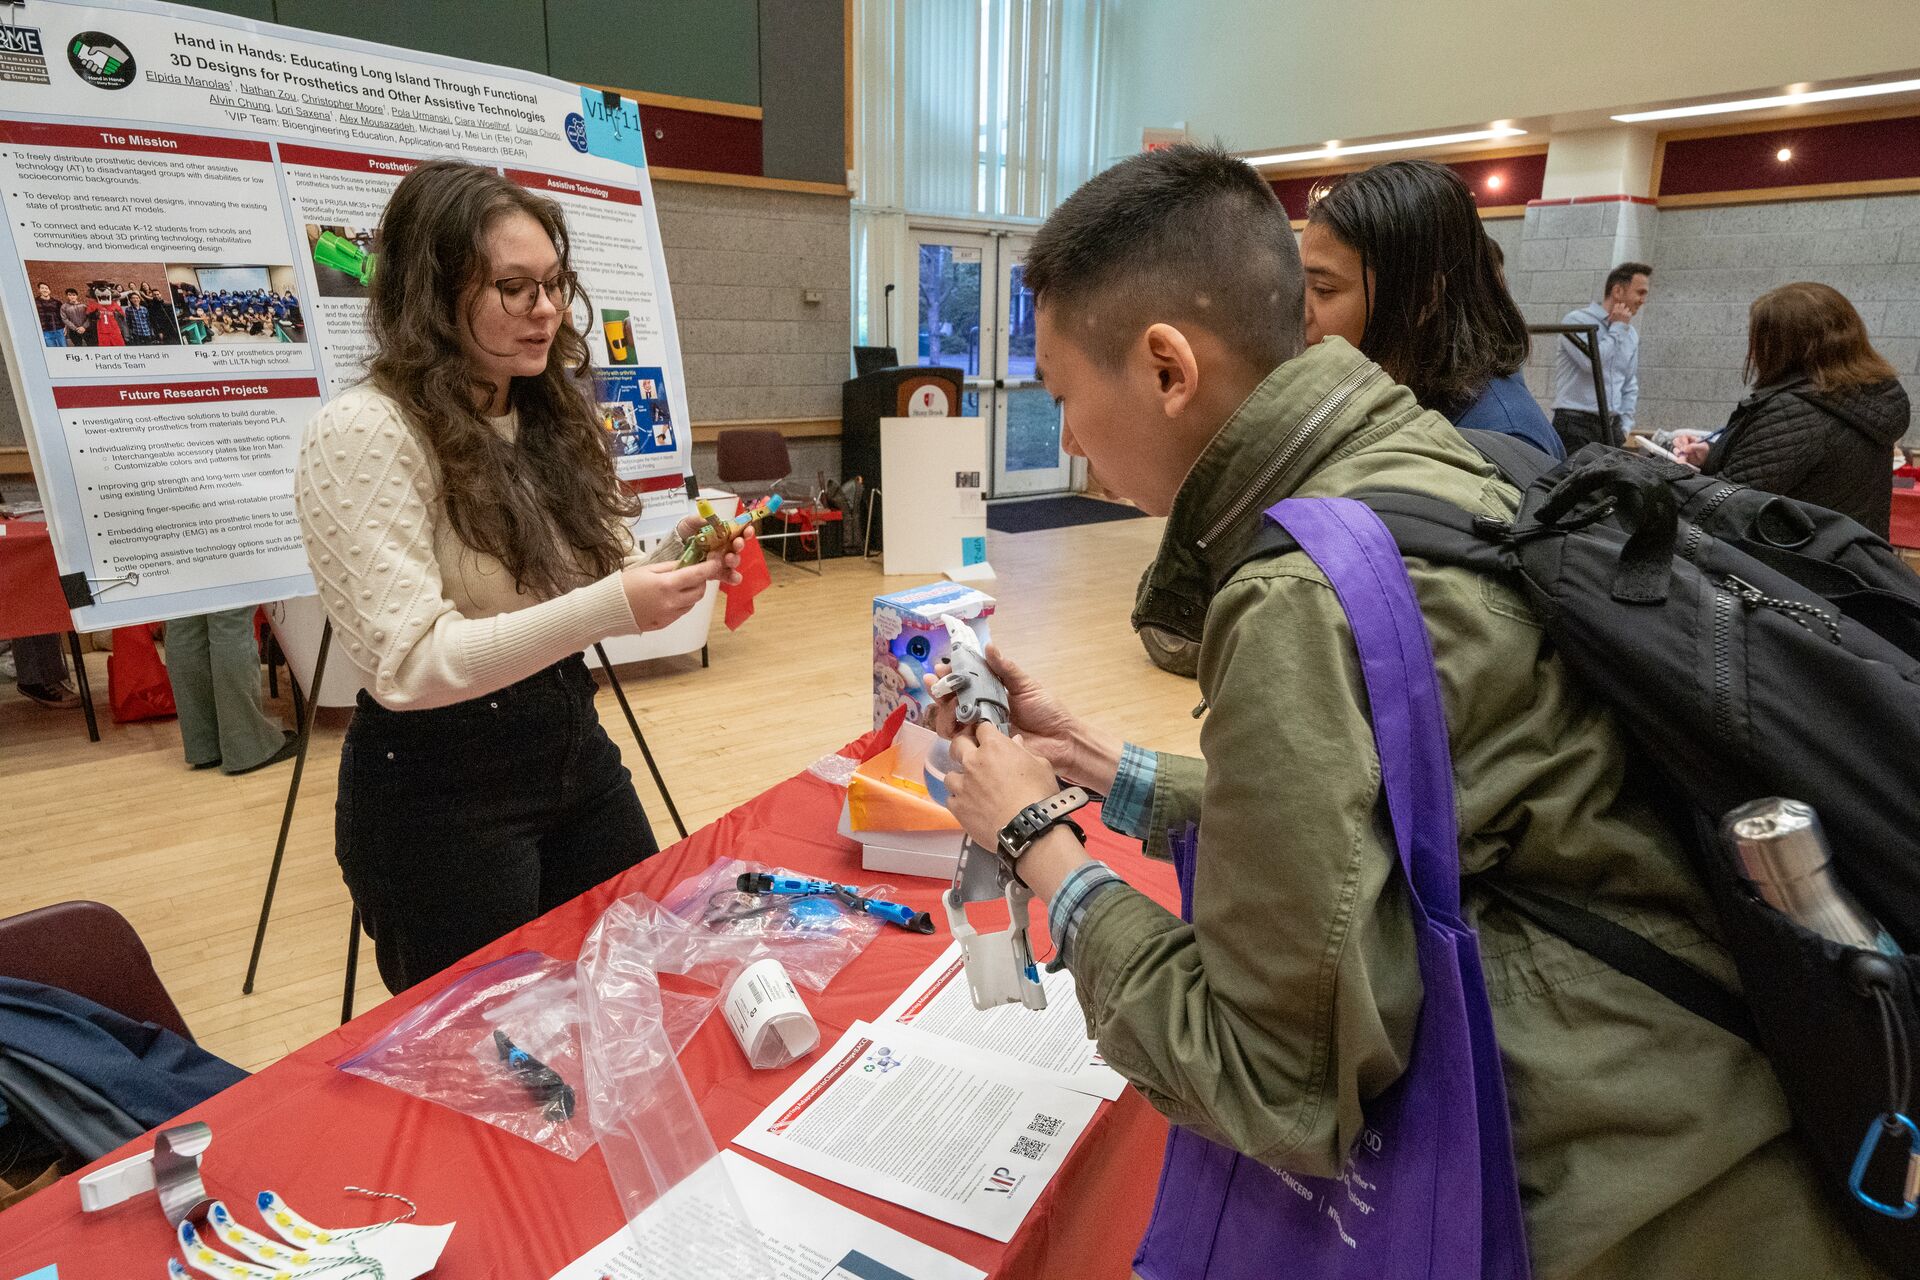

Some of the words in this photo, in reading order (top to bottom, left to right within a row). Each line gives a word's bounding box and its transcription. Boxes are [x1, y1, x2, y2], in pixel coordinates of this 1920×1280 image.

[174, 33, 215, 51] Hand
[219, 42, 233, 54] in
[237, 45, 286, 64] Hands:
[290, 54, 358, 78] Educating
[360, 66, 392, 84] Long
[394, 71, 430, 88] Island
[435, 78, 480, 97] Through
[483, 86, 537, 104] Functional
[170, 54, 192, 68] 3D
[196, 58, 257, 79] Designs
[260, 69, 279, 82] for
[284, 72, 358, 95] Prosthetics
[362, 87, 384, 99] and
[389, 89, 420, 104] Other
[424, 94, 475, 112] Assistive
[478, 102, 545, 123] Technologies
[146, 72, 181, 85] Elpida
[240, 86, 276, 99] Nathan
[302, 95, 354, 111] Christopher
[392, 108, 410, 119] Pola
[516, 125, 538, 136] Louisa
[208, 94, 235, 106] Alvin
[275, 104, 293, 115] Lori
[338, 113, 358, 124] Alex
[418, 124, 450, 136] Michael
[464, 130, 479, 140] Mei
[480, 132, 493, 141] Lin
[494, 133, 513, 146] (Ete)
[513, 136, 532, 146] Chan
[100, 134, 126, 145] The
[128, 136, 177, 148] Mission
[251, 115, 279, 127] Team:
[282, 120, 350, 140] Bioengineering
[398, 137, 444, 150] Application
[443, 143, 460, 152] and
[461, 144, 499, 155] Research
[499, 147, 528, 160] (BEAR)
[26, 152, 51, 162] freely
[52, 154, 93, 163] distribute
[94, 157, 135, 166] prosthetic
[136, 159, 168, 168] devices
[206, 164, 238, 172] assistive
[546, 179, 575, 191] Assistive
[576, 184, 608, 198] Technology
[65, 353, 83, 362] Fig.
[119, 391, 160, 400] Future
[163, 388, 220, 398] Research
[222, 386, 268, 397] Projects
[81, 416, 133, 425] Investigating
[134, 413, 185, 422] cost-effective
[186, 412, 220, 420] solutions
[97, 481, 139, 491] Improving
[140, 479, 156, 488] grip
[157, 476, 189, 485] strength
[190, 474, 205, 482] and
[205, 472, 240, 482] long-term
[257, 467, 284, 476] comfort
[106, 525, 154, 536] Embedding
[154, 520, 197, 530] electronics
[214, 514, 250, 526] prosthetic
[114, 562, 138, 571] bottle
[175, 555, 190, 564] and
[192, 552, 227, 562] signature
[228, 548, 254, 559] guards
[266, 542, 302, 552] individuals
[1362, 1129, 1382, 1152] OD
